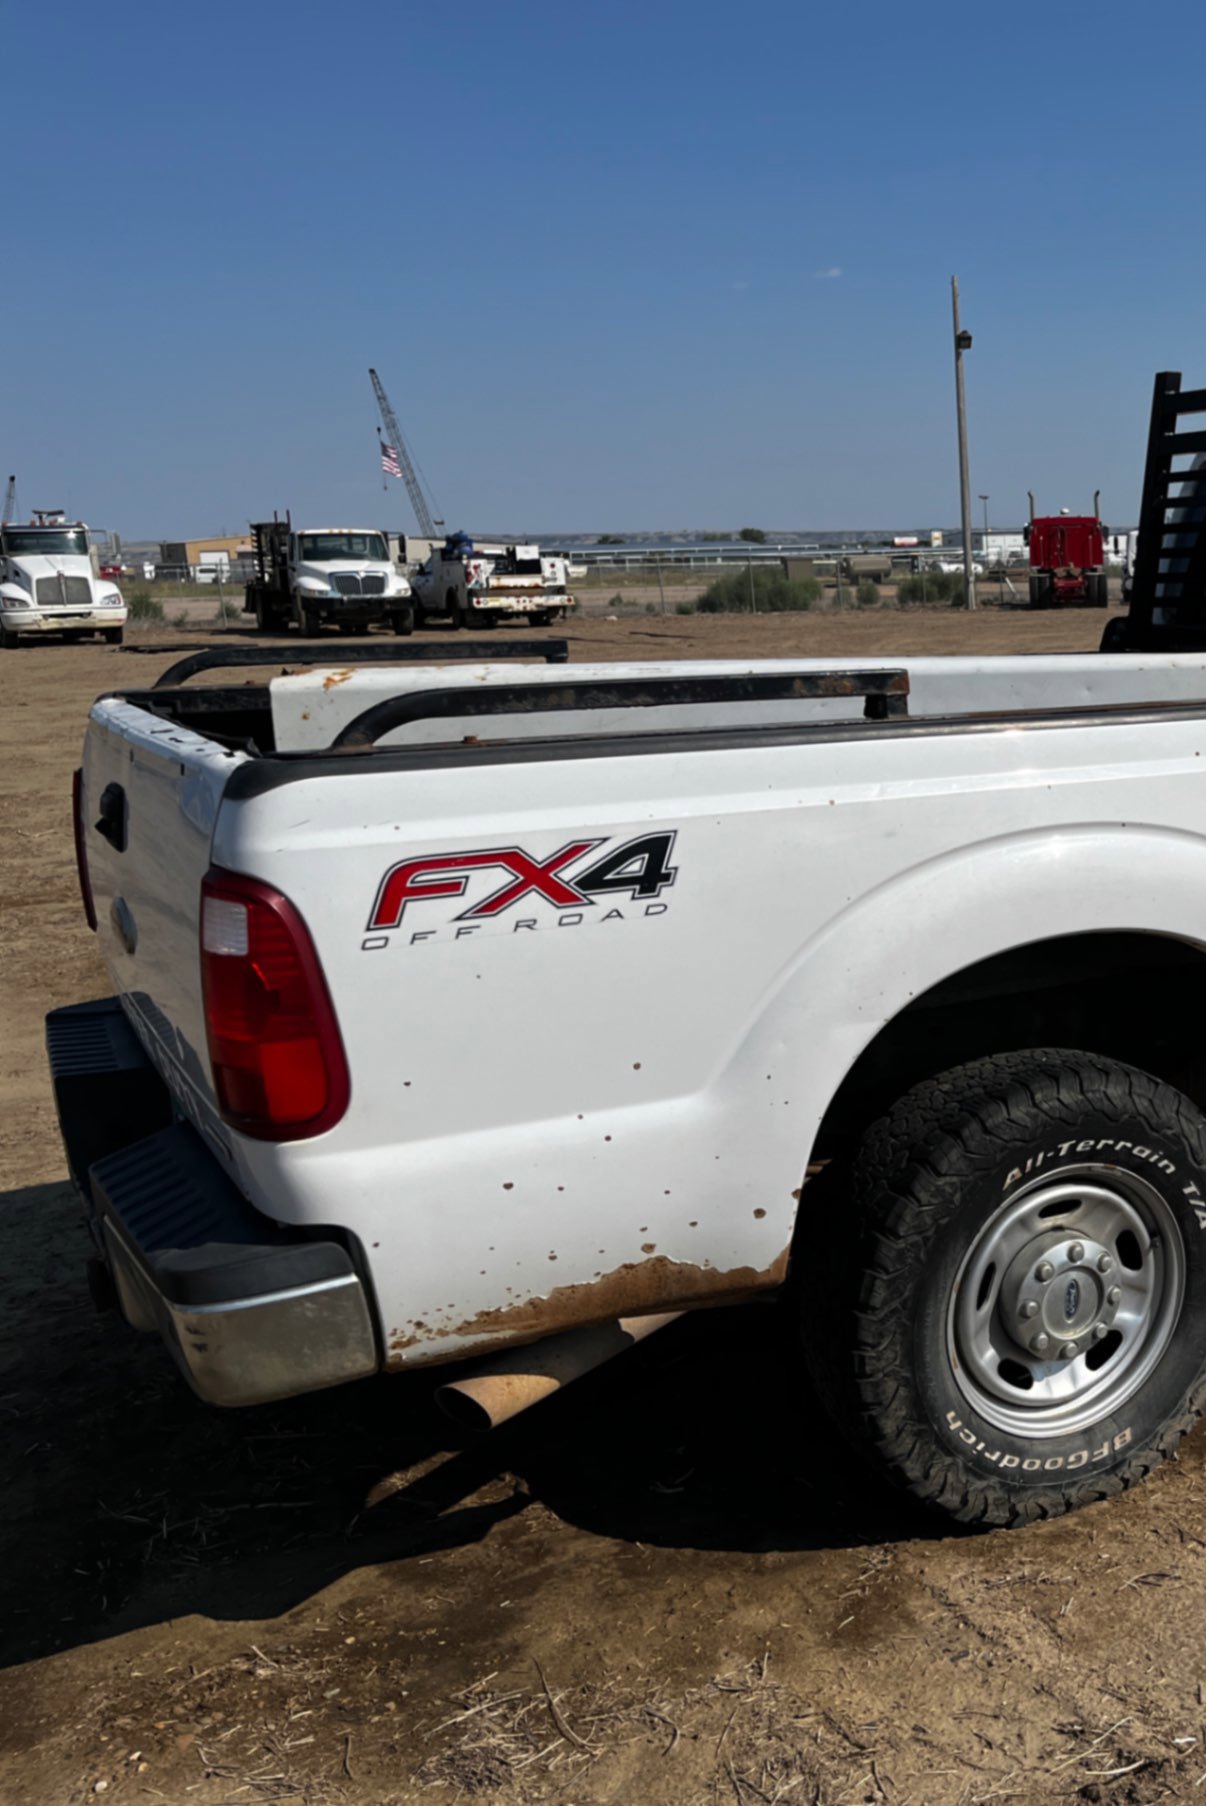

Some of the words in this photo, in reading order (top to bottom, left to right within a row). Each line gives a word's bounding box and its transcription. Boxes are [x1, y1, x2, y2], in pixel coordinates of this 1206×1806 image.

[365, 830, 679, 932] FX4
[1002, 1139, 1176, 1191] All-Terrain
[946, 1410, 1133, 1471] BFGoodrich
